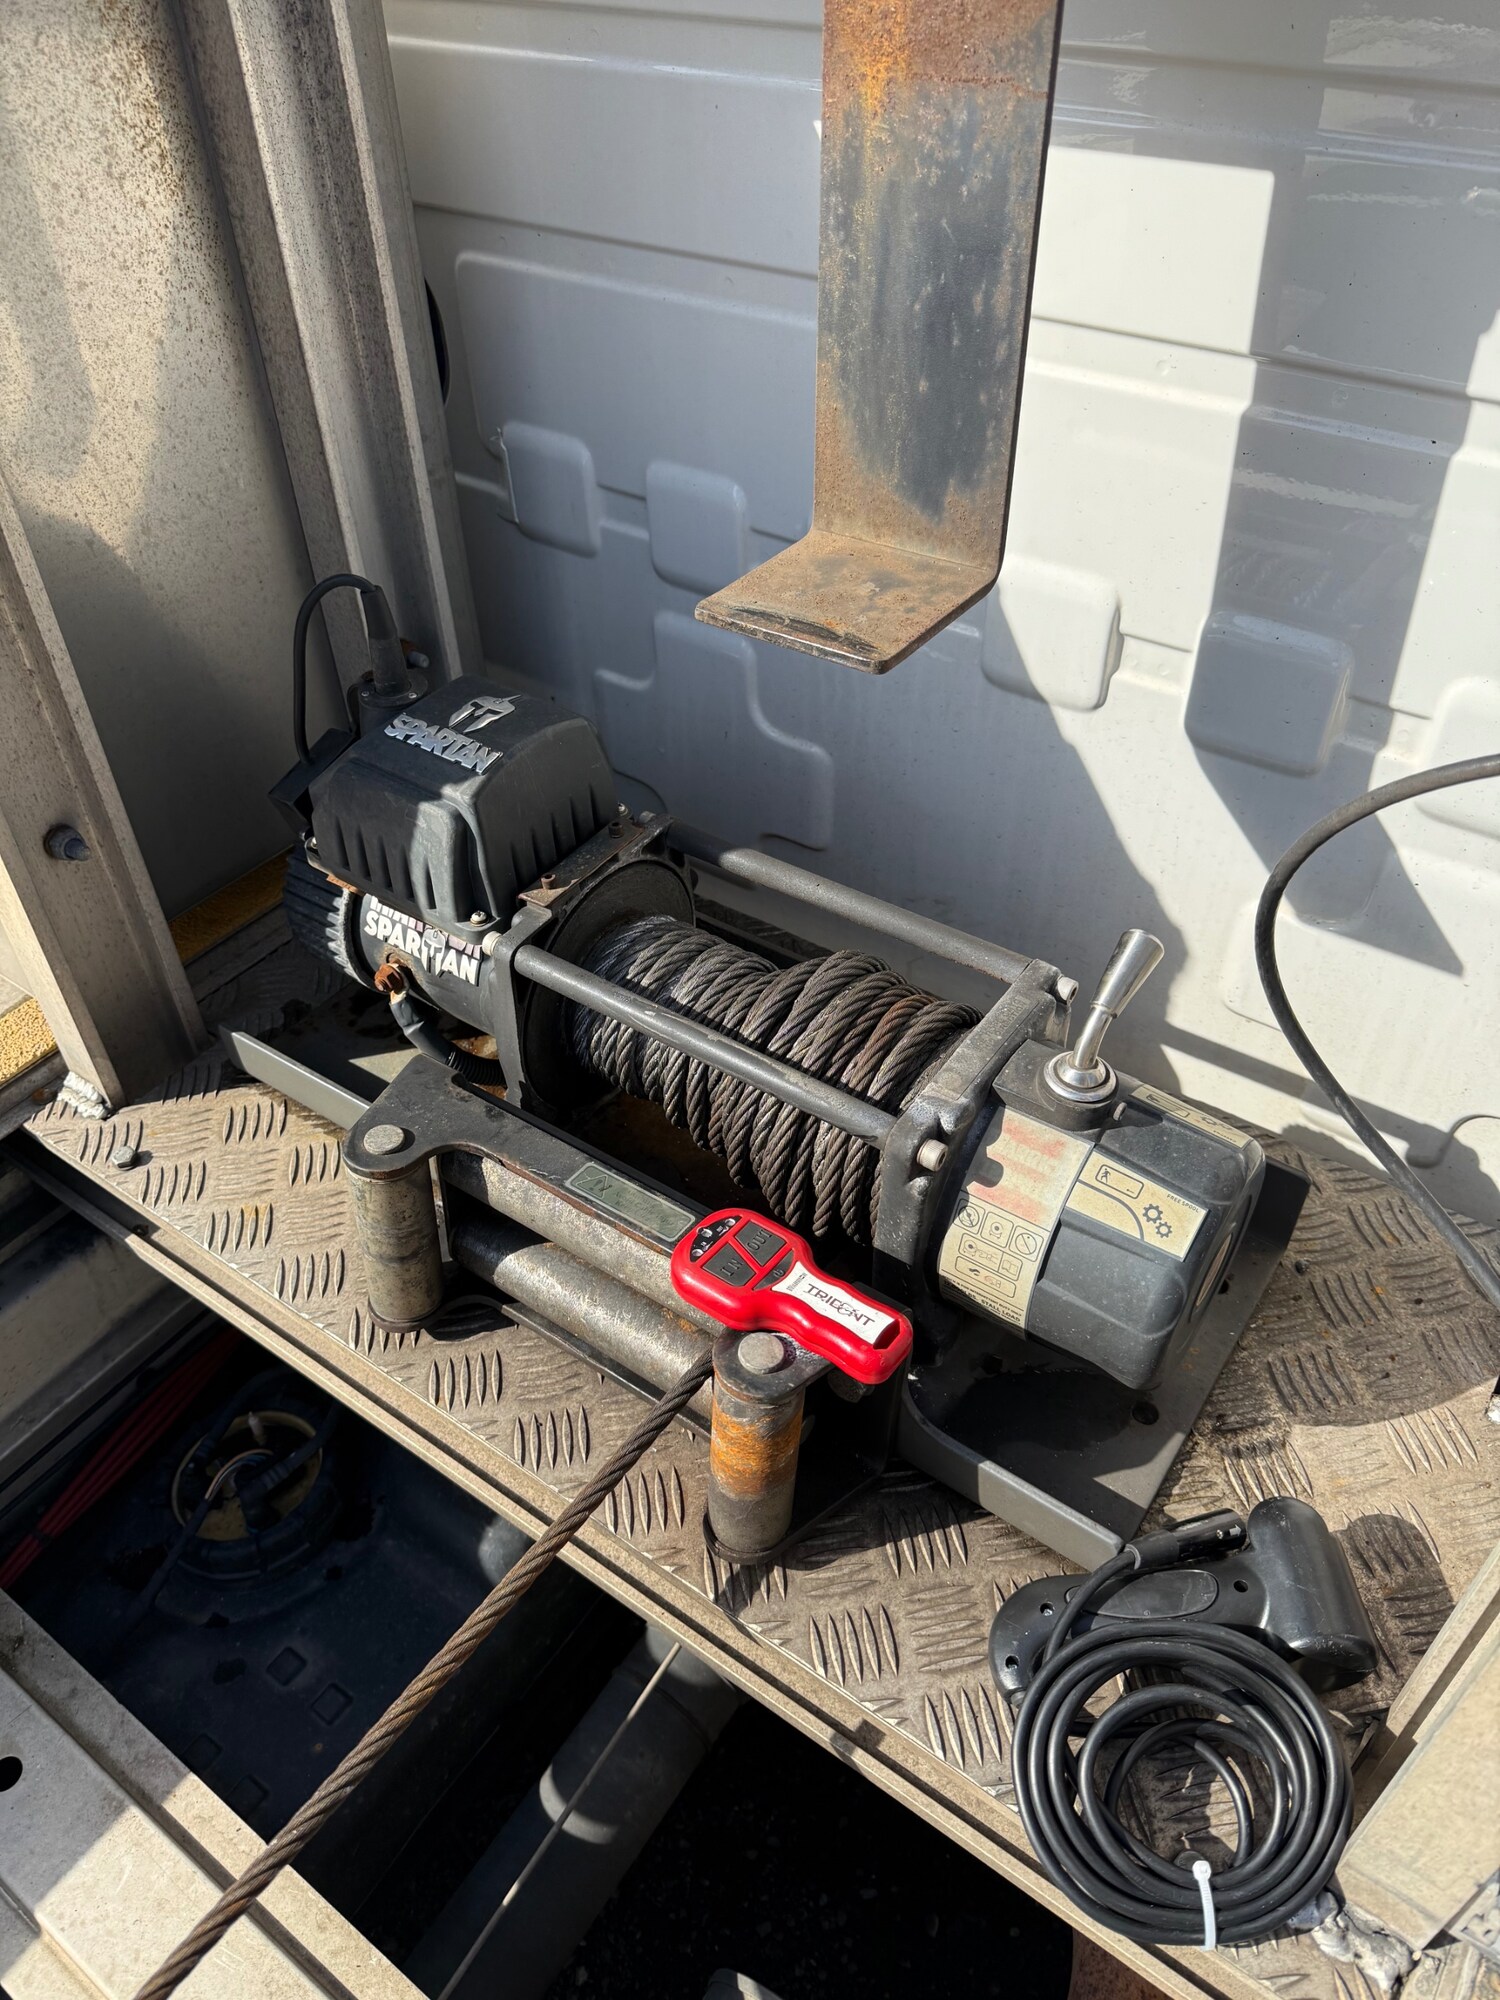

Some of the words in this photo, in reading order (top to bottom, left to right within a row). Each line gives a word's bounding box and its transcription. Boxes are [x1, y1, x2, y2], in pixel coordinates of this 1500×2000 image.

[384, 712, 503, 775] SPARTAN
[364, 910, 480, 986] SPARTAN
[1166, 1194, 1181, 1204] FREE
[1181, 1200, 1199, 1213] SPOOL
[746, 1229, 772, 1251] OUT
[720, 1258, 743, 1277] IN
[980, 1299, 1001, 1312] STALL
[1001, 1309, 1021, 1322] LOAD
